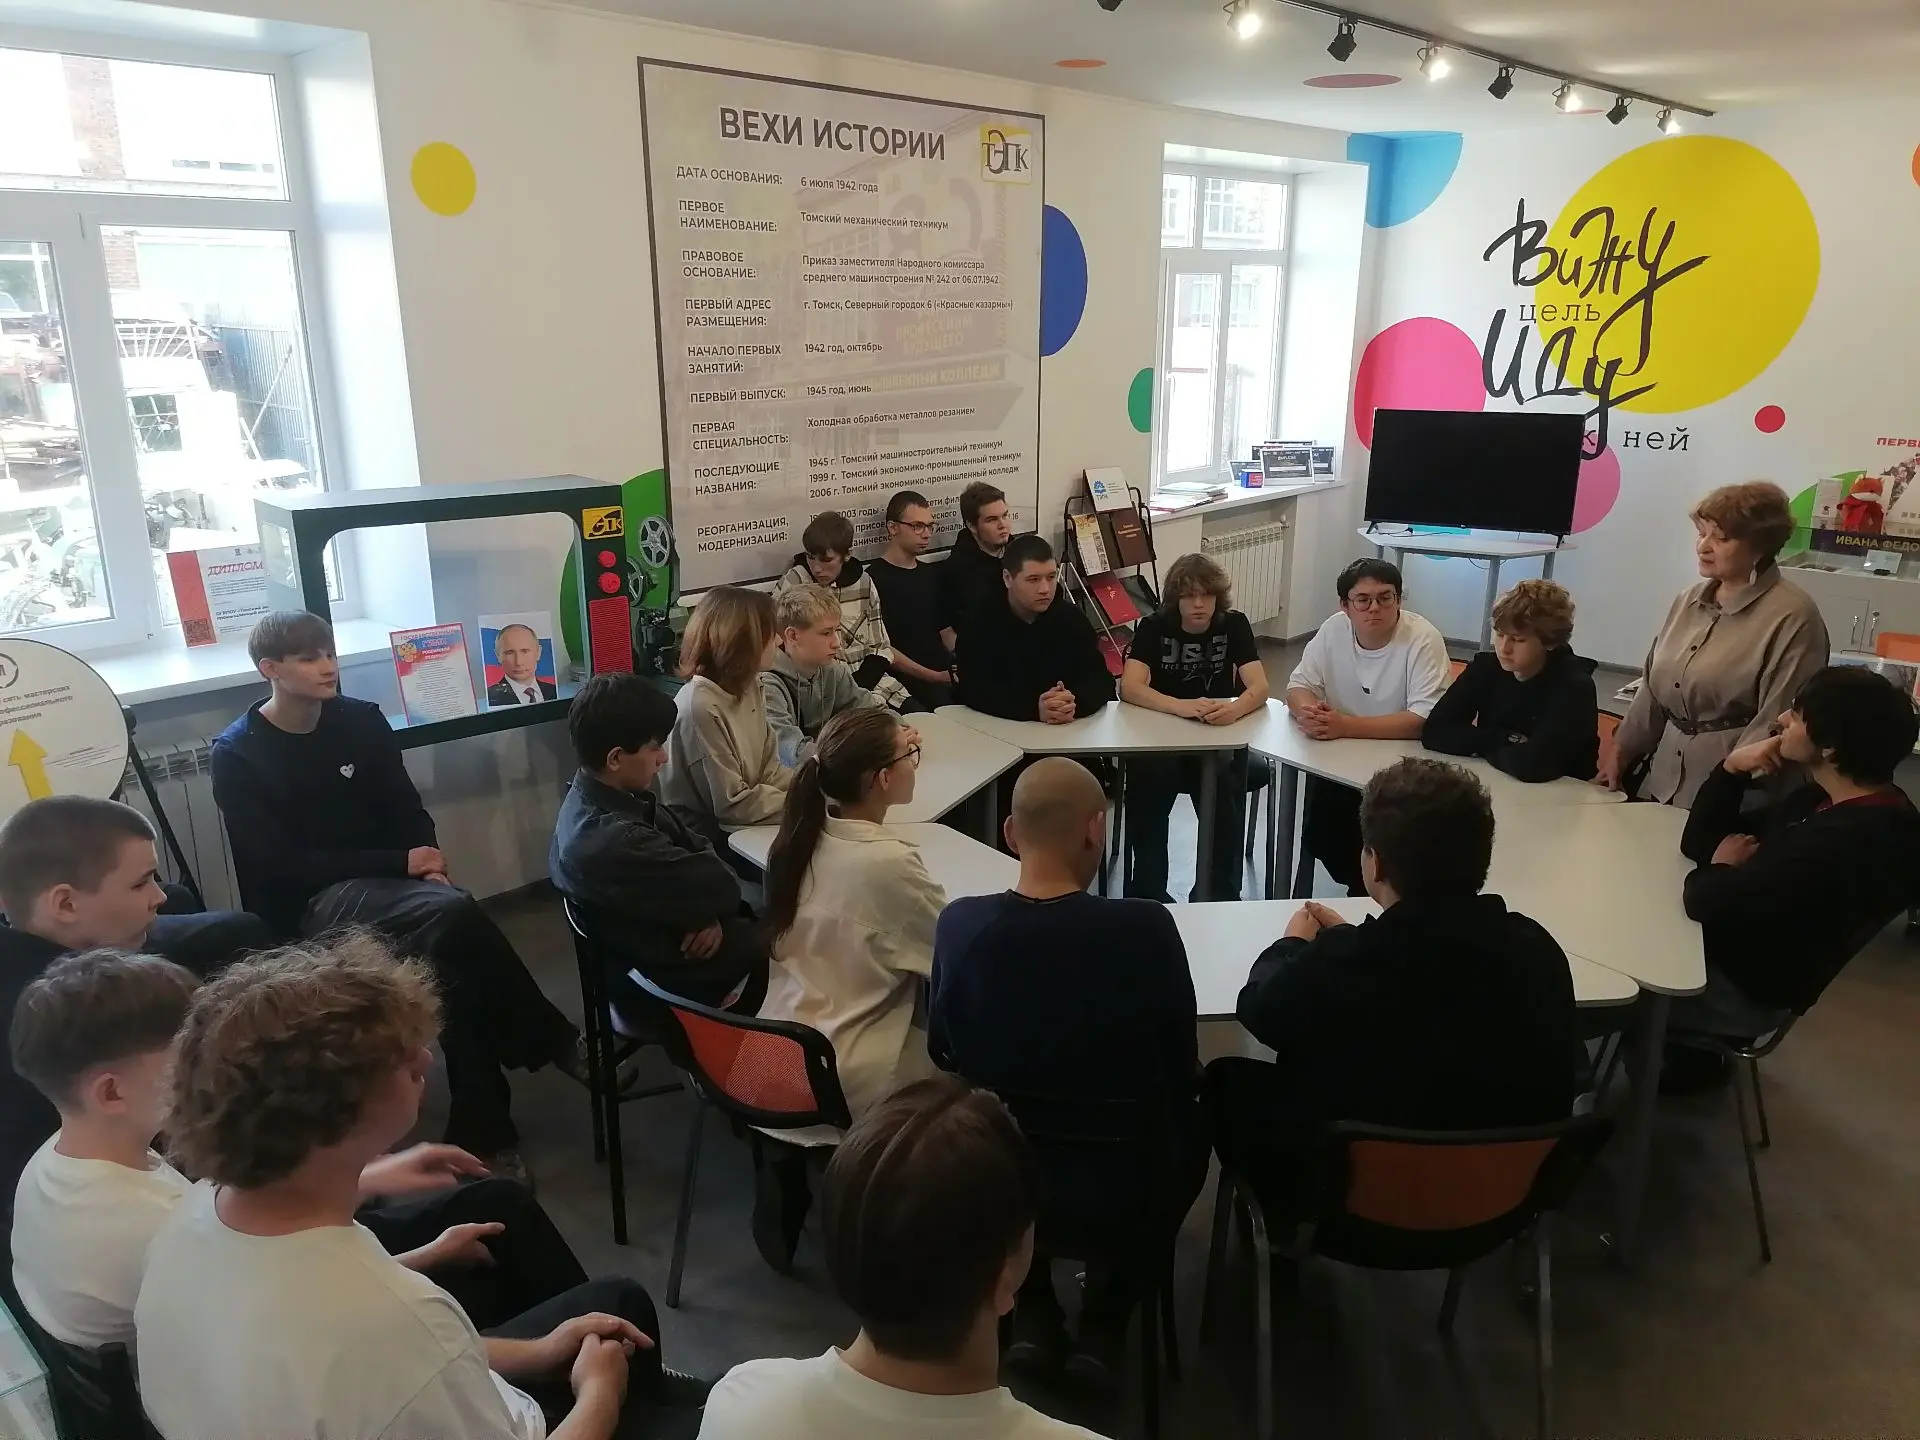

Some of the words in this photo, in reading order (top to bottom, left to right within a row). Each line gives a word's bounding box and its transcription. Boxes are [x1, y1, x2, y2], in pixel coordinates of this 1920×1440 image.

[719, 106, 803, 146] ВЕХИ
[813, 118, 945, 161] ИСТОРИИ
[676, 165, 709, 180] ДАТА
[710, 168, 783, 185] ОСНОВАНИЯ:
[800, 176, 807, 188] 6
[809, 179, 834, 190] июля
[835, 179, 856, 191] 1942
[858, 182, 879, 194] года
[678, 199, 725, 213] ПЕРВОЕ
[680, 216, 777, 233] НАИМЕНОВАНИЕ:
[800, 211, 842, 224] Томский
[843, 215, 908, 228] механический
[909, 218, 949, 231] техникум
[682, 250, 744, 263] ПРАВОВОЕ
[802, 255, 837, 268] Приказ
[839, 257, 895, 268] заместителя
[897, 257, 942, 270] Народного
[943, 260, 985, 270] комиссара
[683, 266, 756, 279] ОСНОВАНИЕ:
[803, 273, 847, 284] среднего
[849, 273, 924, 285] машиностроения
[925, 273, 935, 284] №
[936, 274, 950, 284] 242
[951, 276, 960, 284] от
[961, 274, 999, 285] 06.07.1942
[685, 297, 733, 310] ПЕРВЫЙ
[736, 299, 772, 311] АДРЕС
[803, 301, 811, 310] г.
[812, 299, 843, 311] Томск,
[844, 299, 889, 310] Северный
[891, 300, 925, 312] городок
[926, 299, 932, 309] 6
[933, 299, 974, 311] («Красные
[1519, 303, 1601, 324] цель
[686, 316, 767, 328] РАЗМЕЩЕНИЯ:
[687, 345, 735, 357] НАЧАЛО
[737, 344, 782, 356] ПЕРВЫХ
[804, 343, 825, 353] 1942
[827, 343, 844, 354] год,
[846, 342, 882, 353] октябрь
[688, 360, 744, 374] ЗАНЯТИЙ:
[690, 388, 737, 403] ПЕРВЫЙ
[740, 388, 786, 401] ВЫПУСК:
[806, 386, 827, 396] 1945
[828, 386, 846, 397] год,
[848, 385, 872, 394] июнь
[807, 416, 851, 428] Холодная
[853, 412, 898, 425] обработка
[900, 410, 937, 421] металлов
[938, 407, 975, 419] резанием
[692, 421, 735, 434] ПЕРВАЯ
[693, 434, 789, 450] СПЕЦИАЛЬНОСТЬ:
[1622, 426, 1690, 452] ней
[1876, 437, 1920, 448] ПЕРВ
[808, 456, 829, 468] 1945
[830, 458, 837, 466] г.
[841, 451, 878, 465] Томский
[880, 442, 968, 461] машиностроительный
[969, 439, 1003, 452] техникум
[694, 461, 780, 479] ПОСЛЕДУЮЩИЕ
[809, 472, 829, 484] 1999
[830, 474, 837, 482] г.
[841, 465, 878, 480] Томский
[880, 455, 988, 475] экономико-промышленный
[988, 451, 1022, 465] техникум
[695, 480, 757, 496] НАЗВАНИЯ:
[809, 487, 832, 499] 2006
[833, 488, 840, 497] г.
[842, 480, 878, 495] Томский
[880, 469, 987, 490] экономико-промышленный
[988, 464, 1020, 476] колледж
[858, 508, 879, 518] годы
[944, 495, 961, 508] фил
[697, 516, 789, 538] РЕОРГАНИЗАЦИЯ,
[855, 521, 887, 534] присое
[932, 510, 957, 520] мского
[698, 531, 788, 553] МОДЕРНИЗАЦИЯ:
[1835, 534, 1879, 549] ИВАНА
[1882, 540, 1920, 553] ФЕДО
[208, 561, 264, 577] ДИПЛОМ
[0, 695, 73, 715] офессионального
